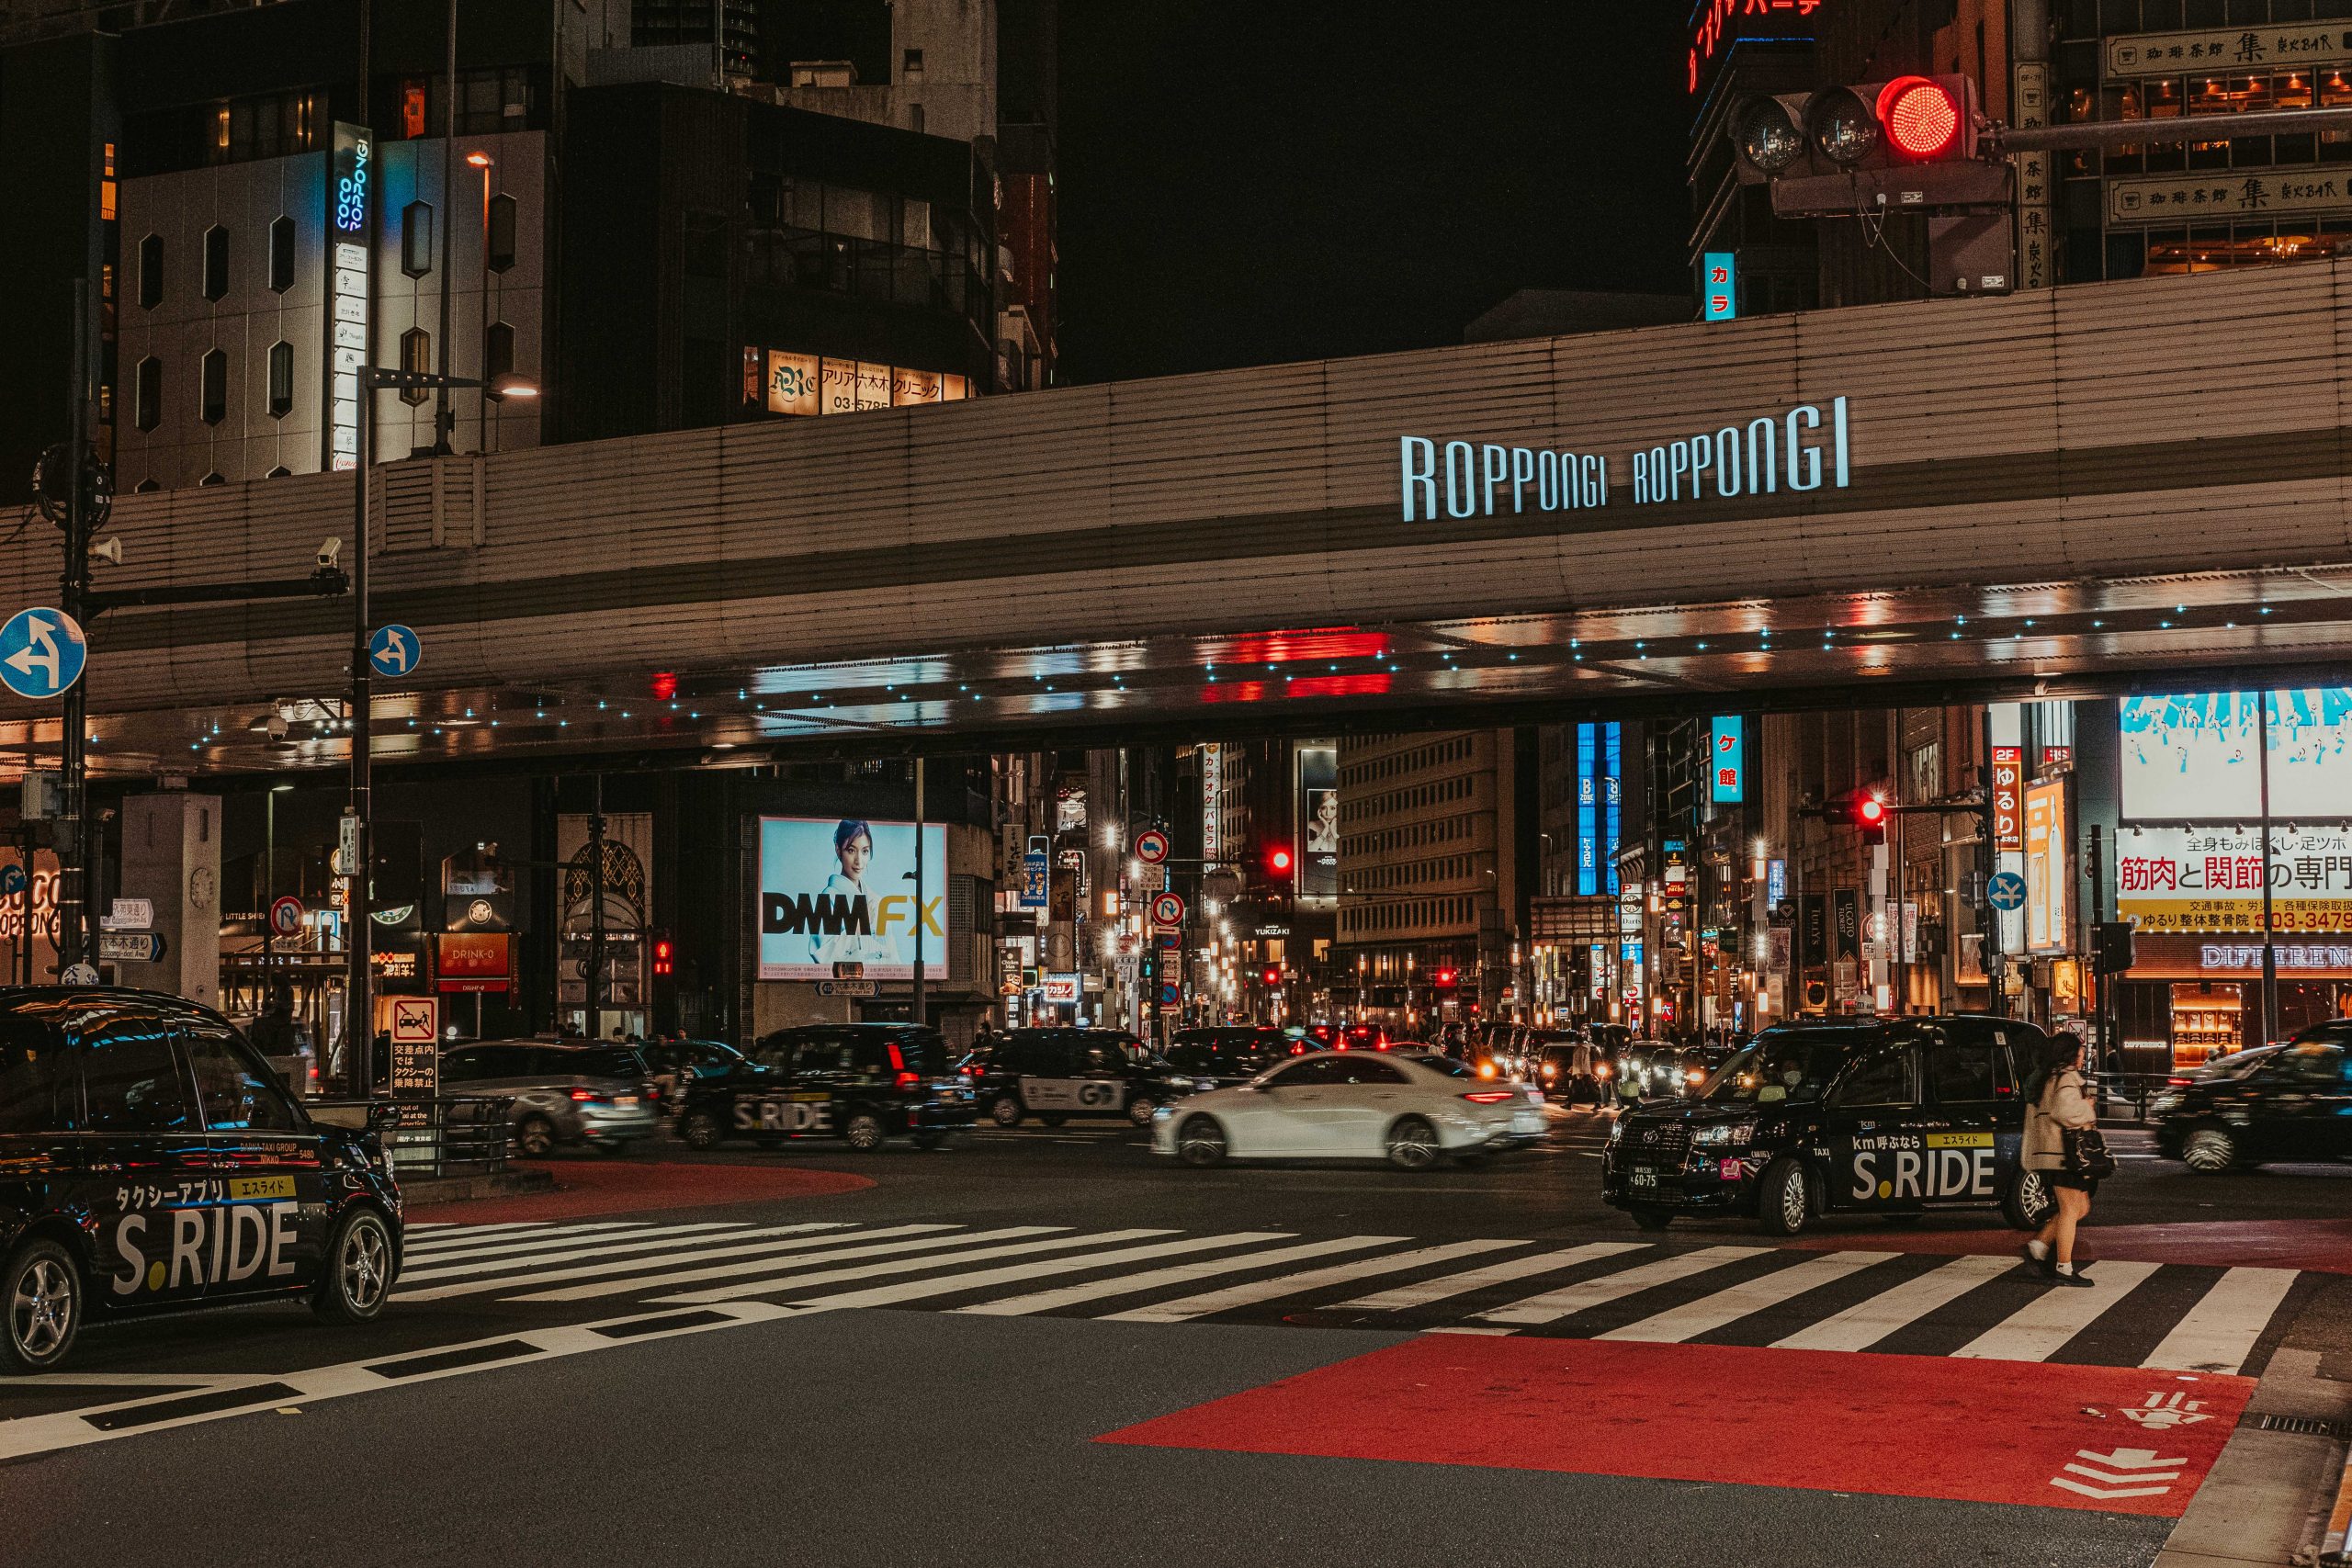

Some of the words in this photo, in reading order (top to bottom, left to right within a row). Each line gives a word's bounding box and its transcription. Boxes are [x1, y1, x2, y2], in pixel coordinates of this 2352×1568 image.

[2233, 32, 2267, 62] 集
[2024, 117, 2042, 200] 珈茶館
[349, 139, 368, 231] ROPPONGI
[2237, 178, 2270, 209] 集
[337, 178, 352, 229] COCO
[1711, 265, 1729, 314] カラ
[822, 369, 940, 398] アリア六本木クリニック
[1401, 436, 1607, 522] ROPPONGI
[1634, 396, 1849, 503] ROPPONGI
[1718, 735, 1737, 786] ケ館
[1996, 749, 2015, 761] 2F
[1204, 757, 1215, 804] カラオケ
[1582, 778, 1591, 794] B
[1996, 767, 2015, 834] ゆるり
[1204, 812, 1215, 846] パセラ
[1997, 835, 2019, 843] 本木店
[2187, 836, 2347, 852] 全身もみほぐし・足ツボ
[2120, 856, 2352, 890] 筋肉と関節の専門
[225, 912, 246, 920] LITTLE
[762, 892, 871, 936] DMM
[876, 895, 944, 937] FX
[2143, 913, 2250, 927] ゆるり整体整骨院
[99, 936, 149, 950] 六本木通り
[2202, 945, 2352, 966] DIFFEREN
[836, 982, 873, 990] 六本木通り
[394, 1045, 434, 1055] 交差点内
[394, 1067, 434, 1077] タクシーの
[394, 1078, 434, 1088] 乗降禁止
[262, 1142, 276, 1153] TAXI
[276, 1142, 298, 1153] GROUP
[1942, 1135, 1978, 1145] エスライド
[260, 1155, 279, 1165] NIKKO
[1813, 1147, 1830, 1156] TAXI
[1634, 1174, 1657, 1187] 60-75
[1852, 1149, 1996, 1200] S.RIDE
[116, 1179, 224, 1212] タクシーアプリ
[242, 1179, 285, 1196] エスライド
[112, 1201, 299, 1295] S.RIDE
